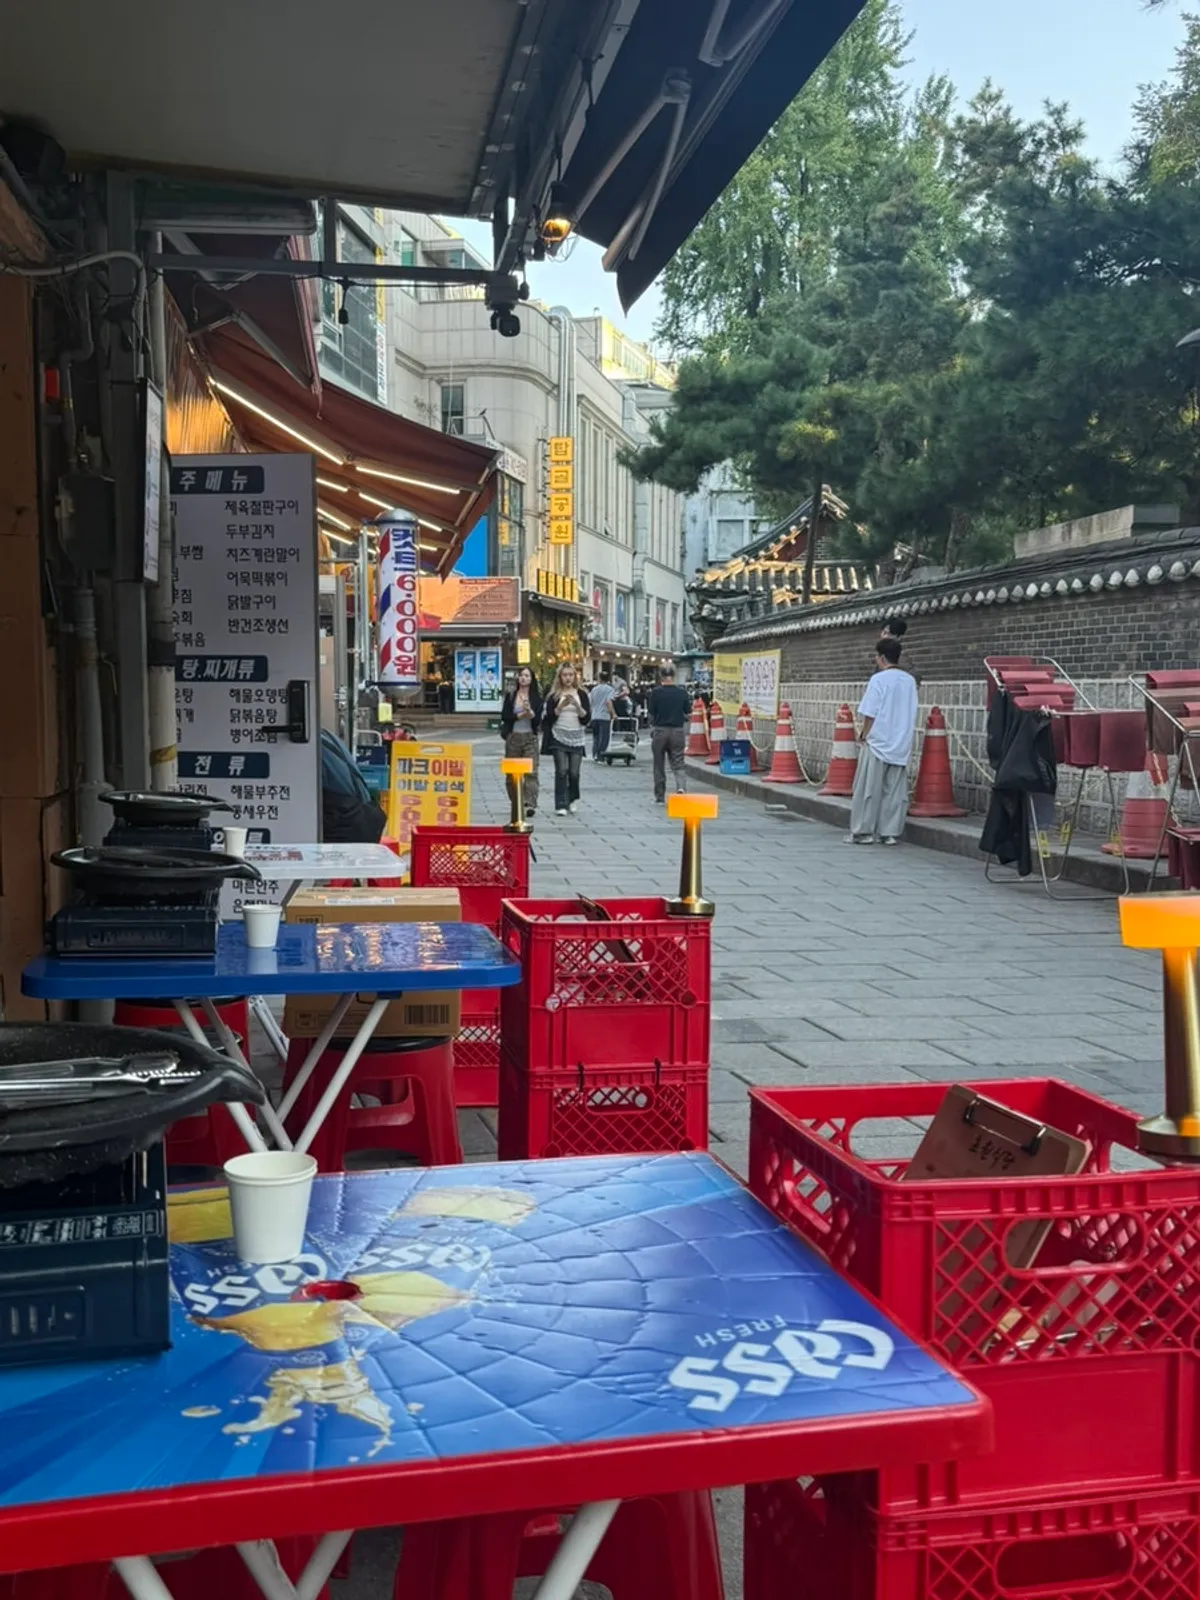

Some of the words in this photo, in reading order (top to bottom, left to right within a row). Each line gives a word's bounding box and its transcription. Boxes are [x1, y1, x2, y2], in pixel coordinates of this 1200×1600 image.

[226, 570, 288, 587] 어묵떡볶이
[227, 594, 276, 610] 닭발구이
[227, 618, 289, 634] 반건조생선
[182, 658, 255, 680] 탕.찌개류
[229, 687, 288, 704] 해물오뎅탕
[229, 707, 278, 724] 닭볶음탕
[232, 880, 279, 895] 마른안주
[693, 1314, 788, 1348] FRESH
